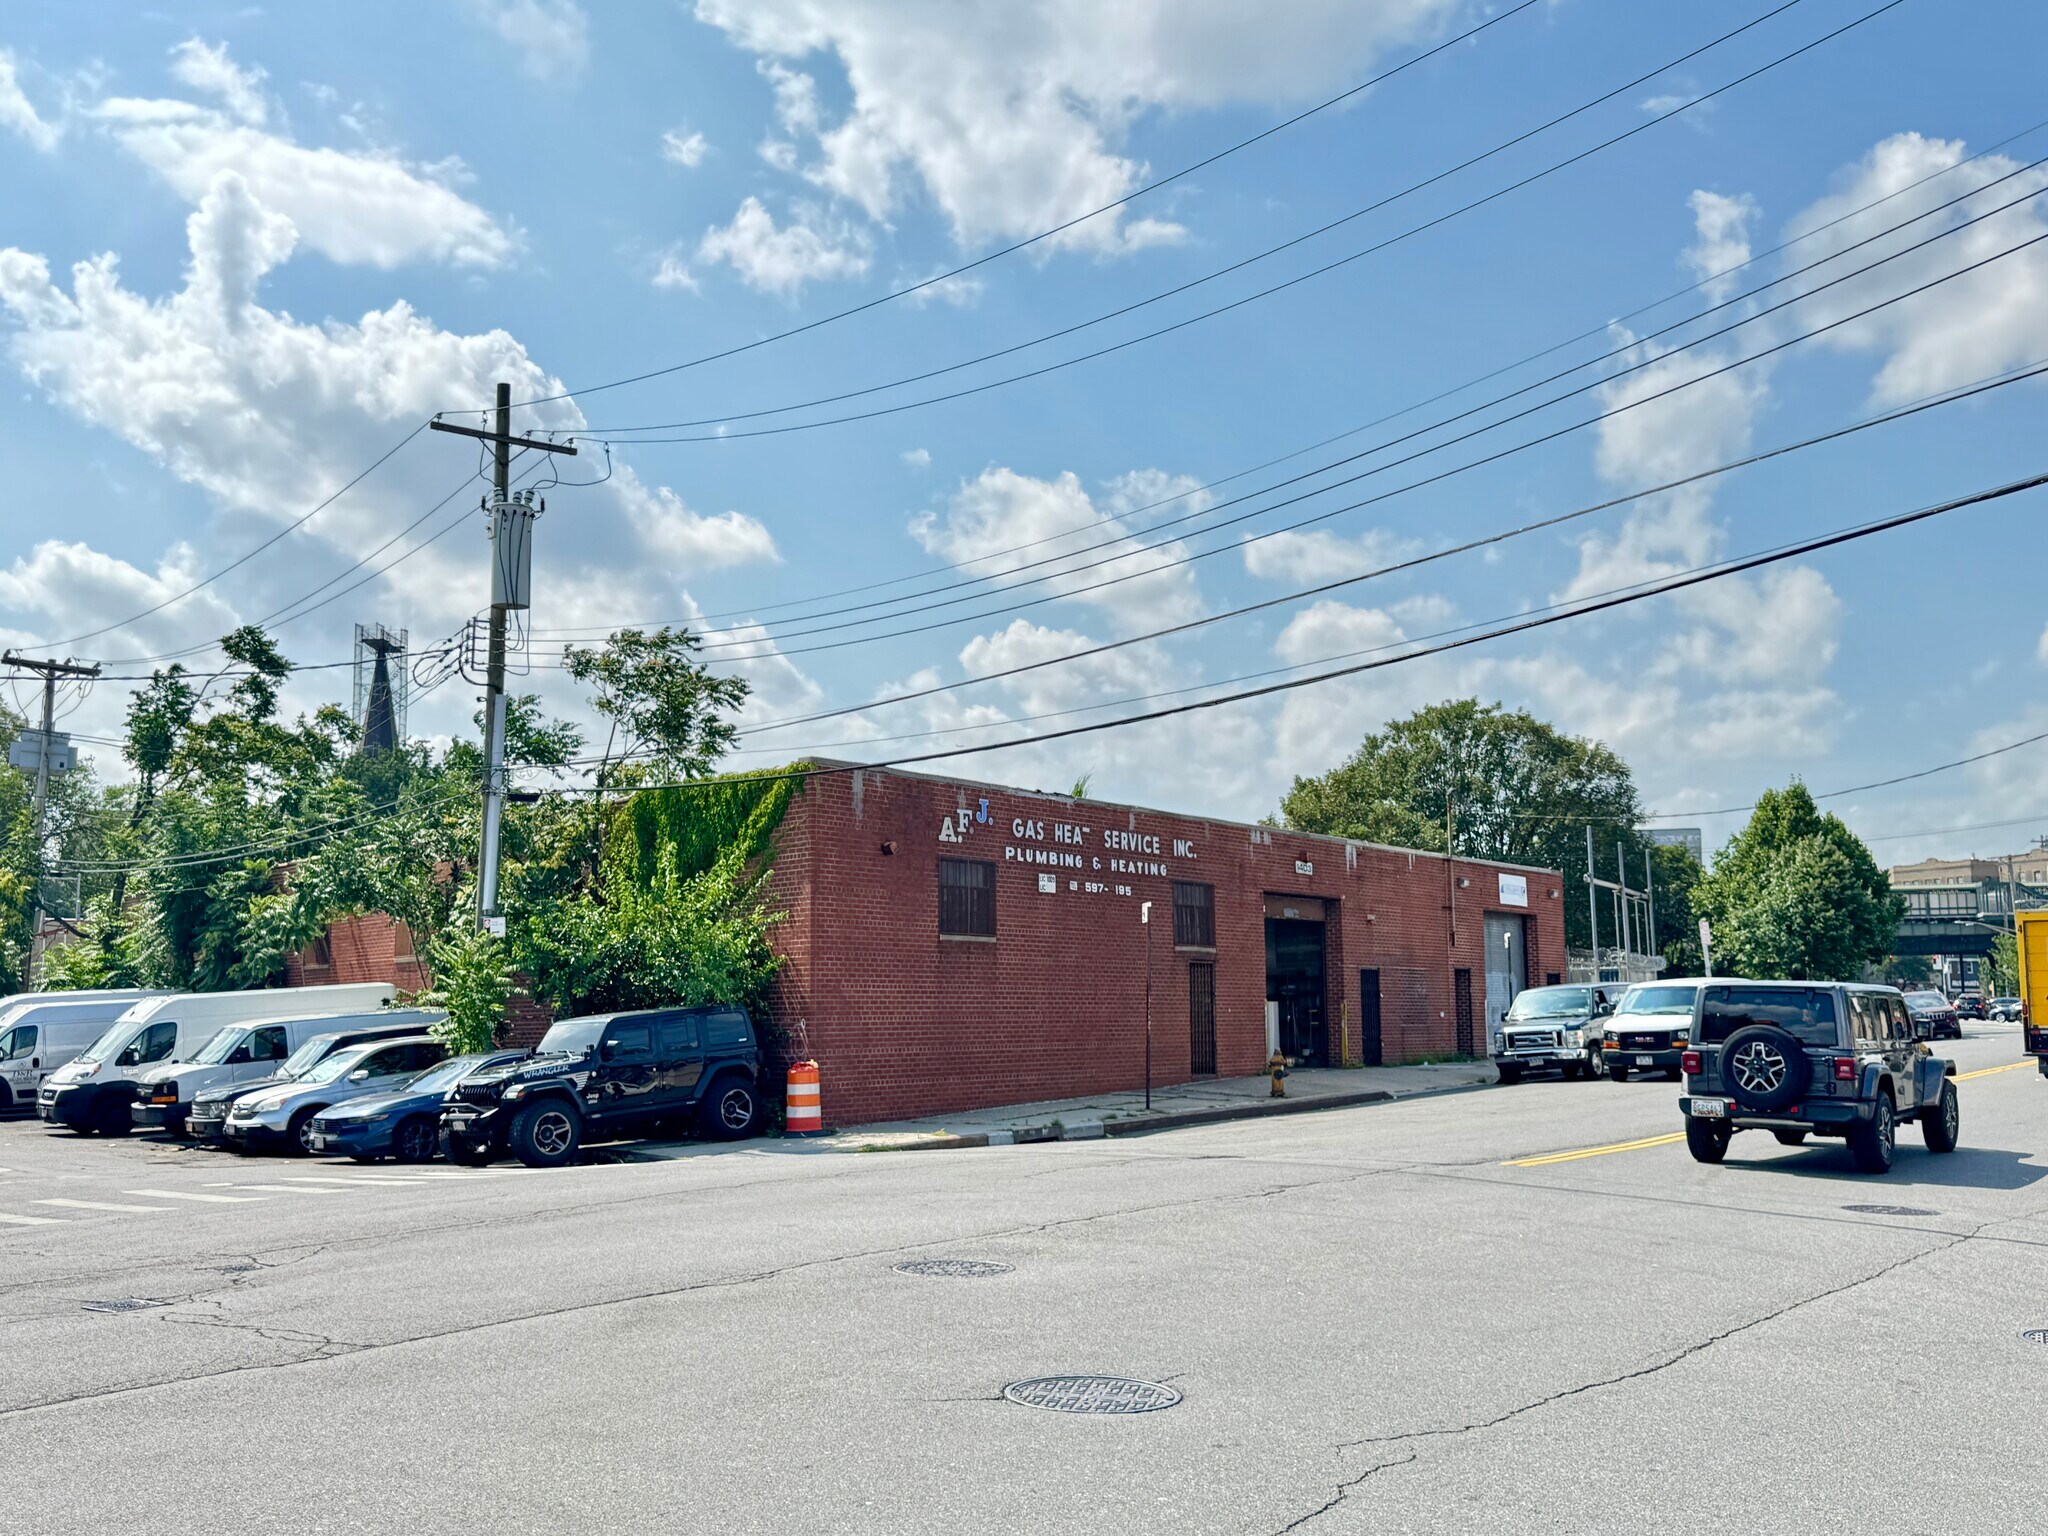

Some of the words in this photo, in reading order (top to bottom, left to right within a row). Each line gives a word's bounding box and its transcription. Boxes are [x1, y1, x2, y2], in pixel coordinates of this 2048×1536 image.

[1012, 818, 1045, 841] GAS
[1054, 823, 1090, 846] HEA
[1104, 829, 1161, 855] SERVICE
[1173, 838, 1198, 859] INC.
[1005, 846, 1083, 869] PLUMBING
[1092, 856, 1102, 870] &
[1110, 858, 1167, 877] HEATING
[1297, 863, 1311, 872] 1403
[1115, 884, 1132, 896] 195
[523, 1064, 570, 1079] WRANGLER
